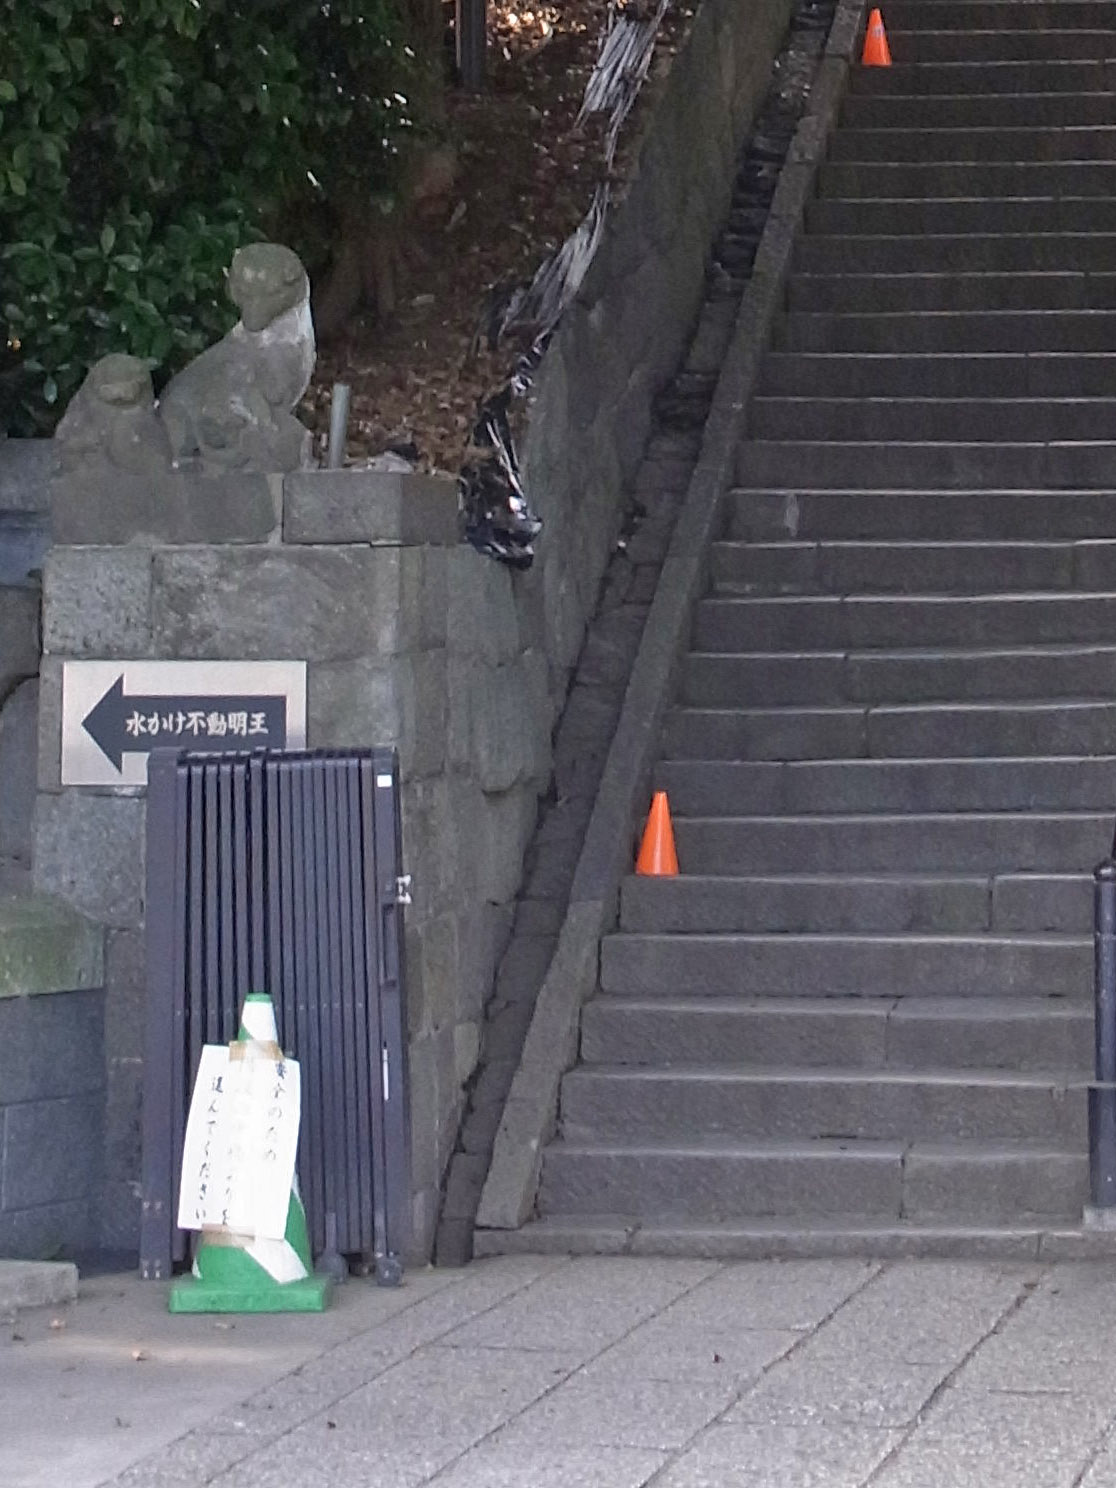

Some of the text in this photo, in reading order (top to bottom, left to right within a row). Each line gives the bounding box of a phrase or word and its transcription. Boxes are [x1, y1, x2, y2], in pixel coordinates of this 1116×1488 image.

[125, 711, 269, 737] 水かけ不動明王
